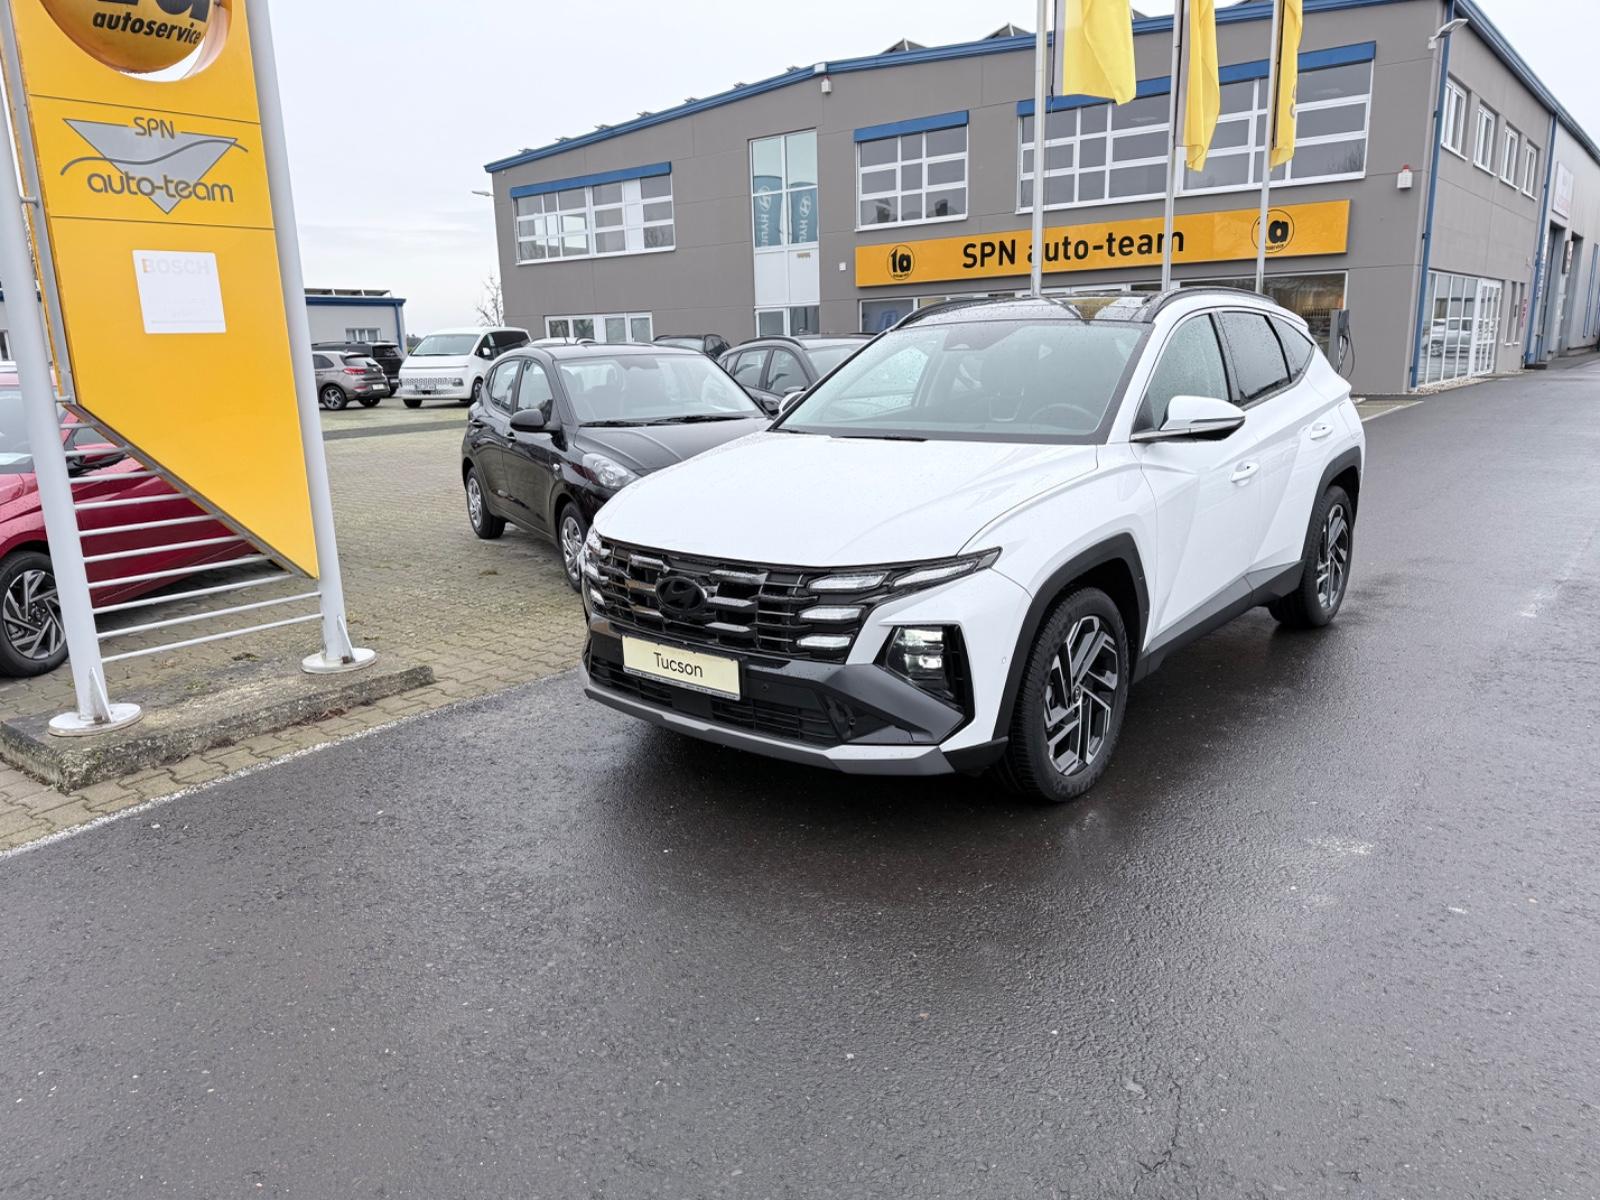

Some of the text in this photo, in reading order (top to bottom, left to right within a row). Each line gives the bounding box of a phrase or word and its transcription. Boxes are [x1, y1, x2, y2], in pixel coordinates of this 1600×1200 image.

[92, 12, 202, 45] autoservice
[133, 117, 175, 140] SPN
[87, 172, 234, 203] auto-team
[890, 248, 912, 273] 1a
[962, 239, 1016, 269] SPN
[653, 652, 703, 678] Tucson
